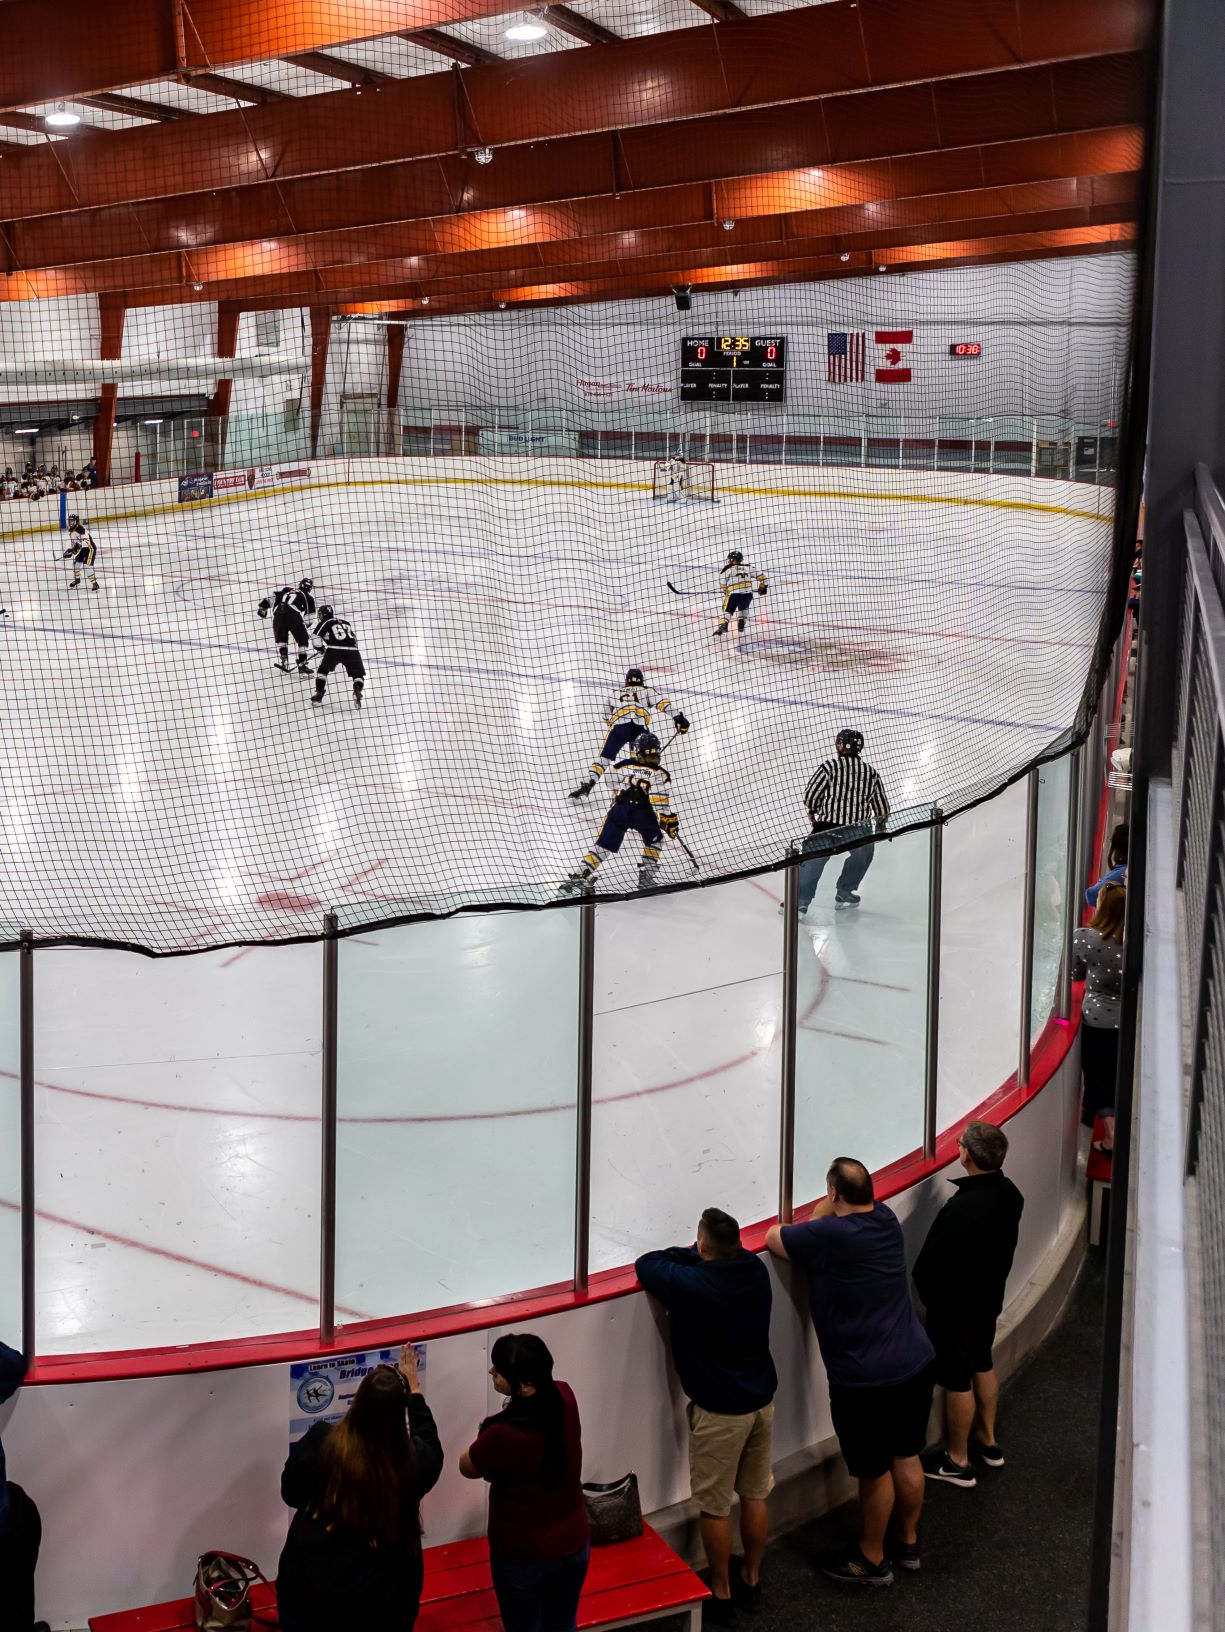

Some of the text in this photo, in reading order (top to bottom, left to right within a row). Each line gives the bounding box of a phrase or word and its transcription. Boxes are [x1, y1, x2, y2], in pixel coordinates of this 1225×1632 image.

[687, 337, 781, 350] HOME 12:35 GUEST
[697, 346, 706, 359] 0
[767, 346, 776, 359] 0
[309, 1363, 328, 1372] Learn
[337, 1359, 355, 1367] Skate
